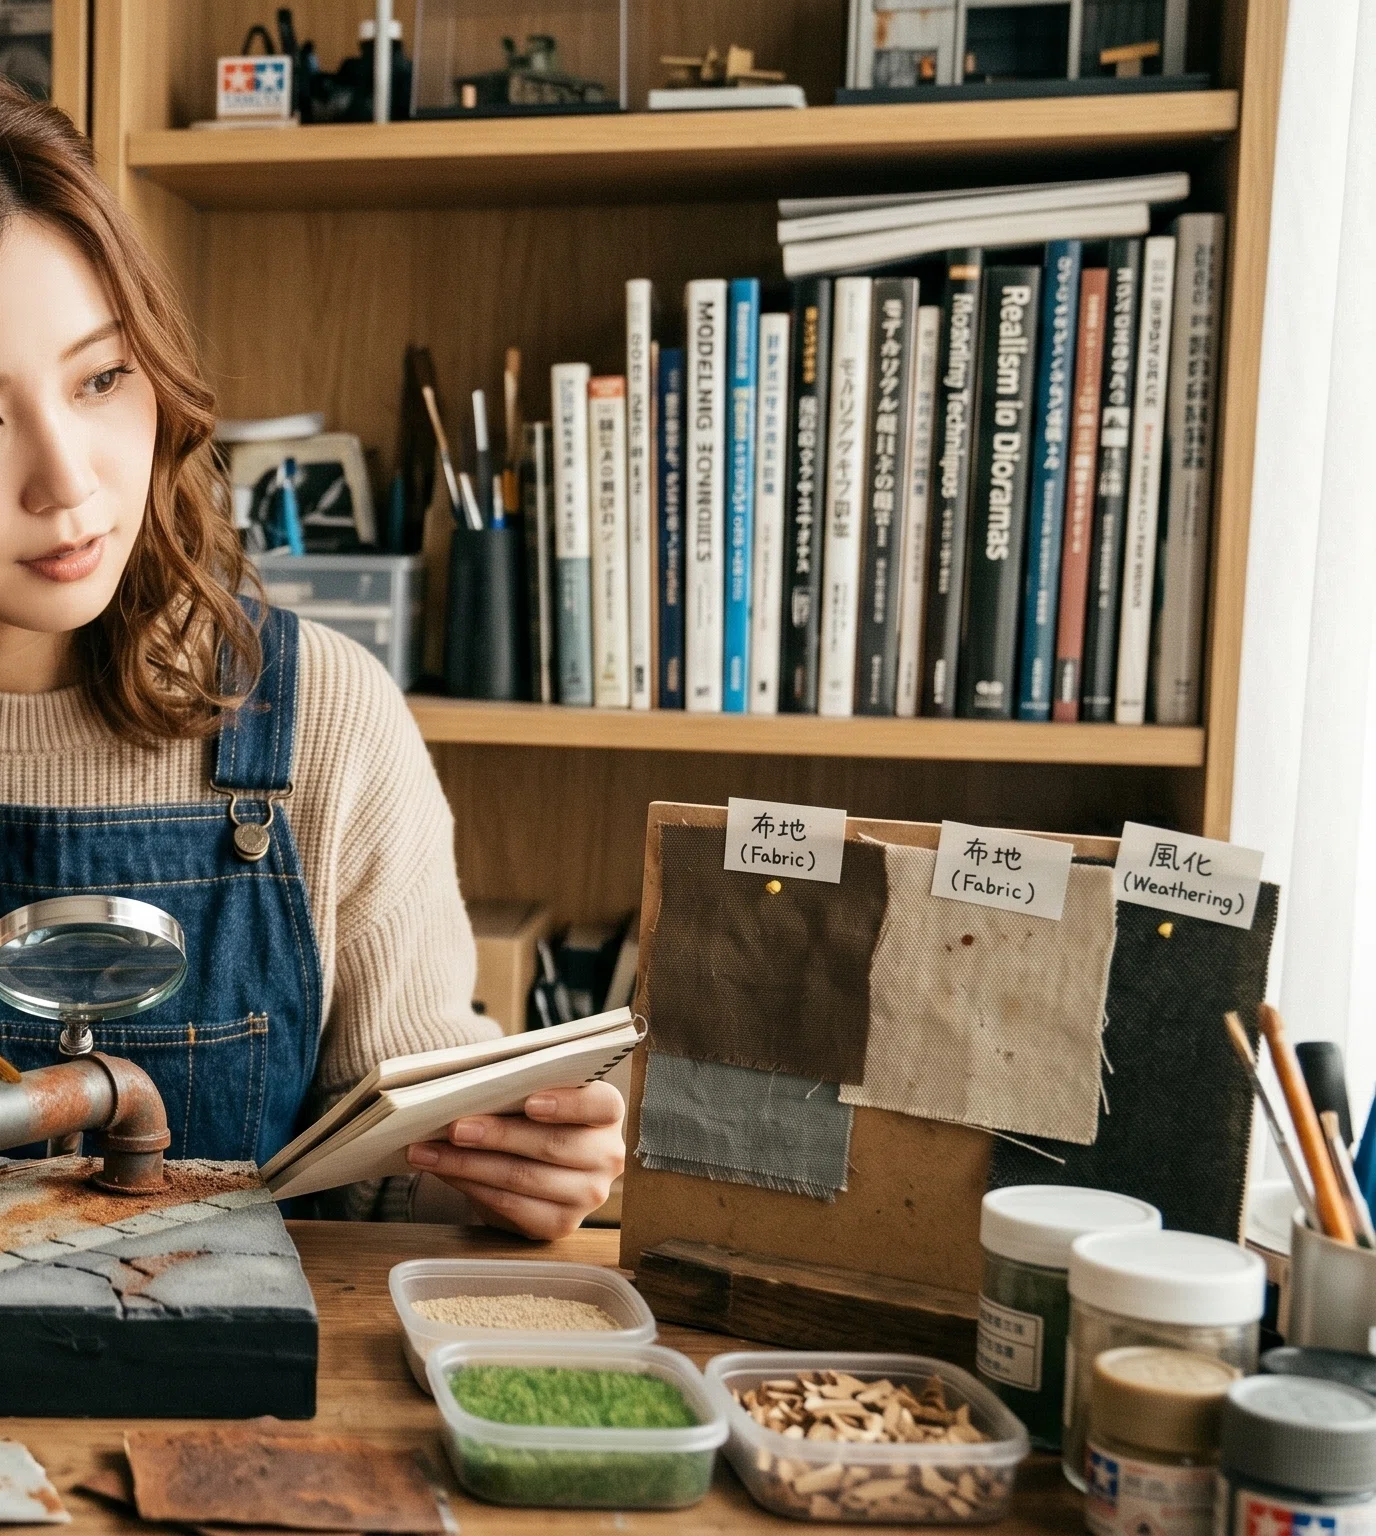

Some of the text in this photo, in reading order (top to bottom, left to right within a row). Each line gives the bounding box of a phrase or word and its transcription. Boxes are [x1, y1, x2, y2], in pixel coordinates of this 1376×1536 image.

[998, 285, 1032, 394] Realism
[985, 430, 1020, 562] Dioramas
[751, 812, 807, 841] 布地
[740, 843, 816, 871] (Fabric)
[963, 837, 1022, 870] 布地
[1149, 843, 1212, 876] 風化
[951, 870, 1035, 904] (Fabric)
[1124, 871, 1244, 915] (Weathering)
